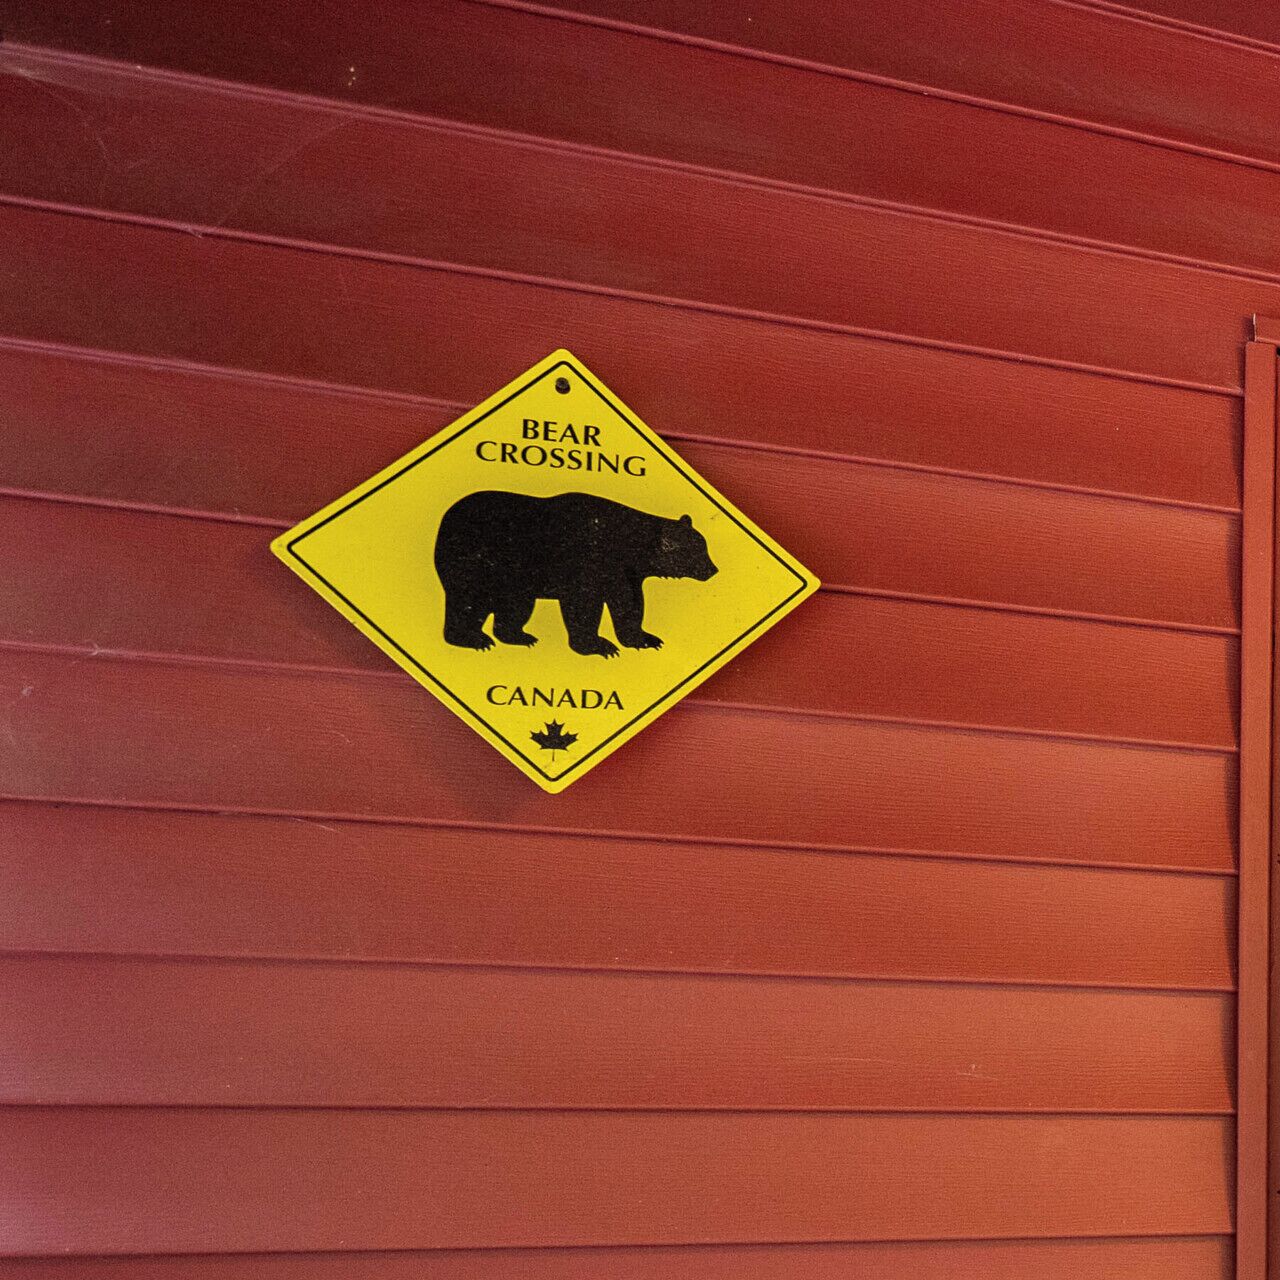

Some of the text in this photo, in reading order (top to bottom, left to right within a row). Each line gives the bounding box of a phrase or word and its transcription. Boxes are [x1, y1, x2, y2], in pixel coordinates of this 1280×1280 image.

[522, 418, 601, 447] BEAR
[475, 441, 647, 477] CROSSING
[485, 684, 625, 711] CANADA
